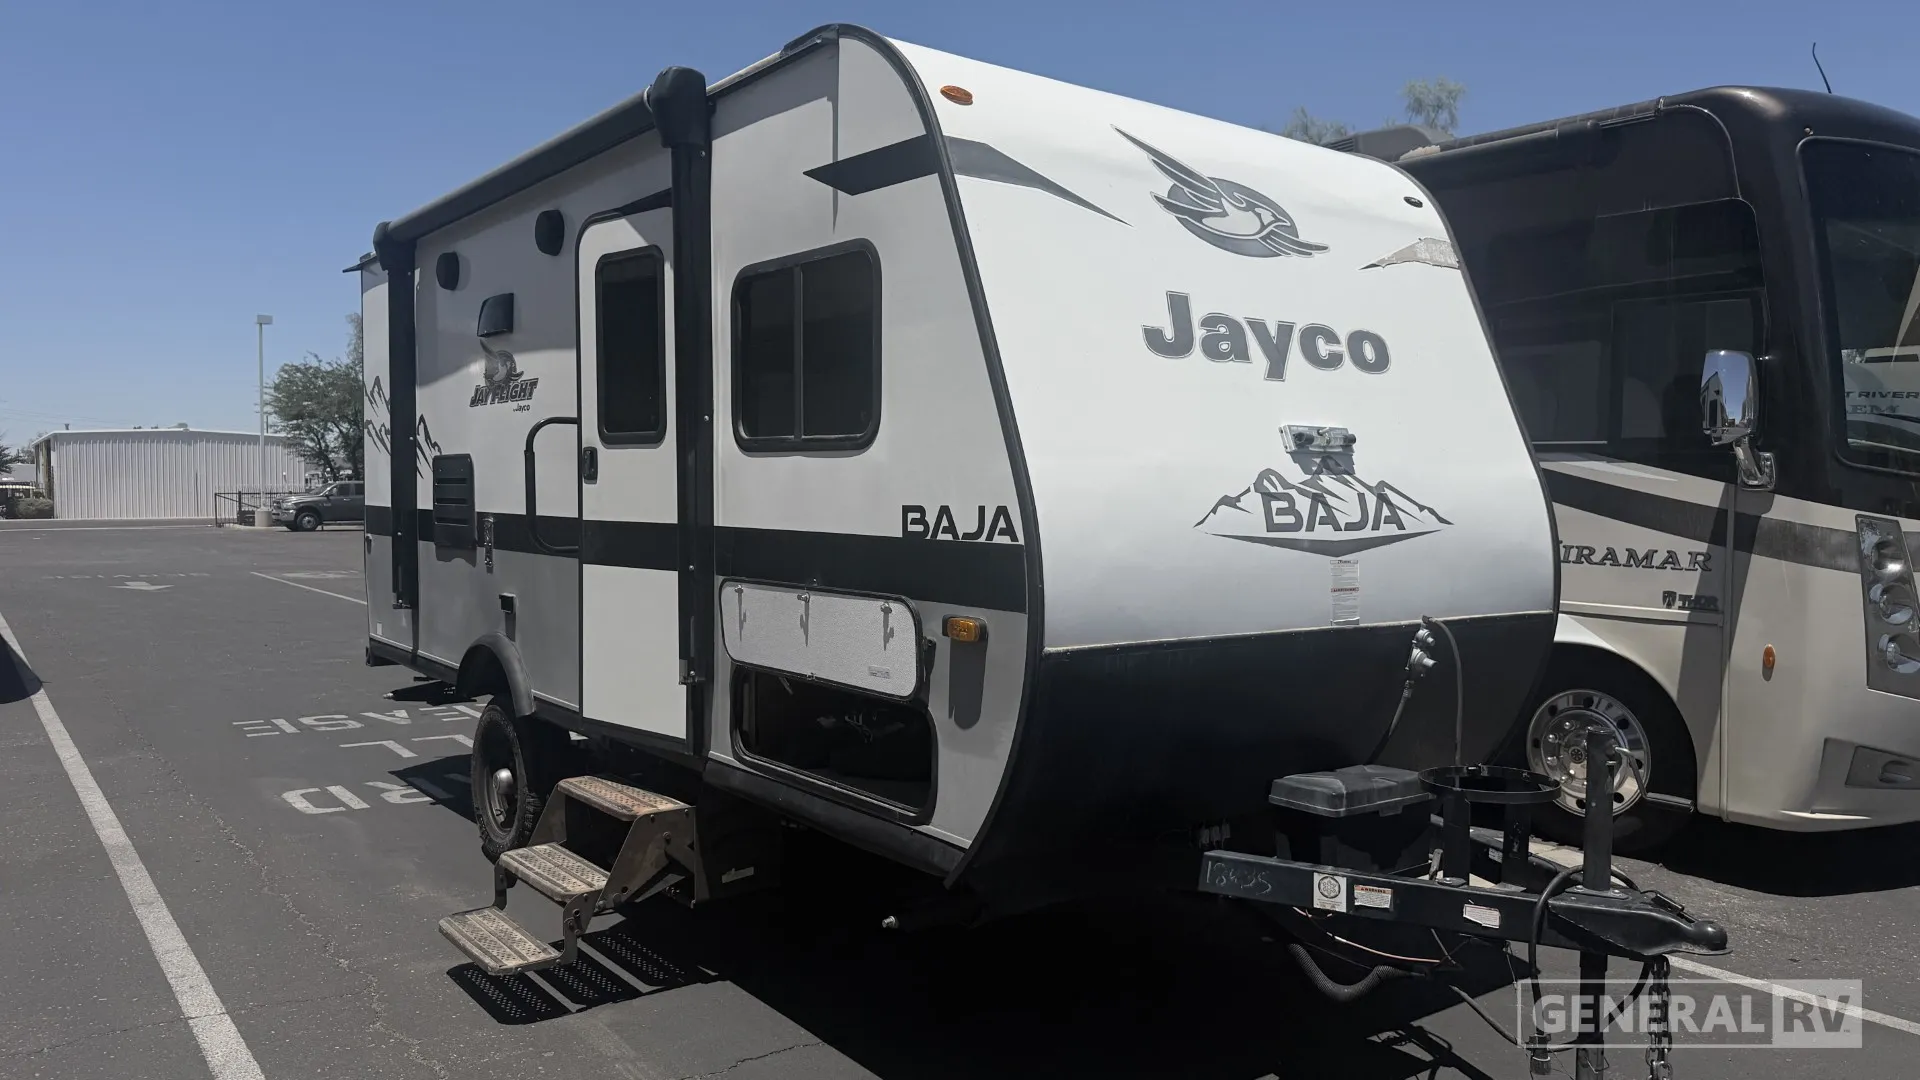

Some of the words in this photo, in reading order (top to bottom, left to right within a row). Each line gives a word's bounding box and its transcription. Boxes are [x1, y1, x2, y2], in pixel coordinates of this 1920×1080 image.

[1142, 290, 1392, 382] Jayco
[469, 385, 491, 407] JAY
[490, 378, 539, 405] FLIGHT
[1858, 391, 1920, 399] RIVER
[515, 403, 531, 413] Jayco
[900, 504, 1020, 543] BAJA
[1261, 491, 1406, 533] BAJA
[1560, 542, 1713, 572] IRAMAR
[1678, 594, 1719, 611] THOR
